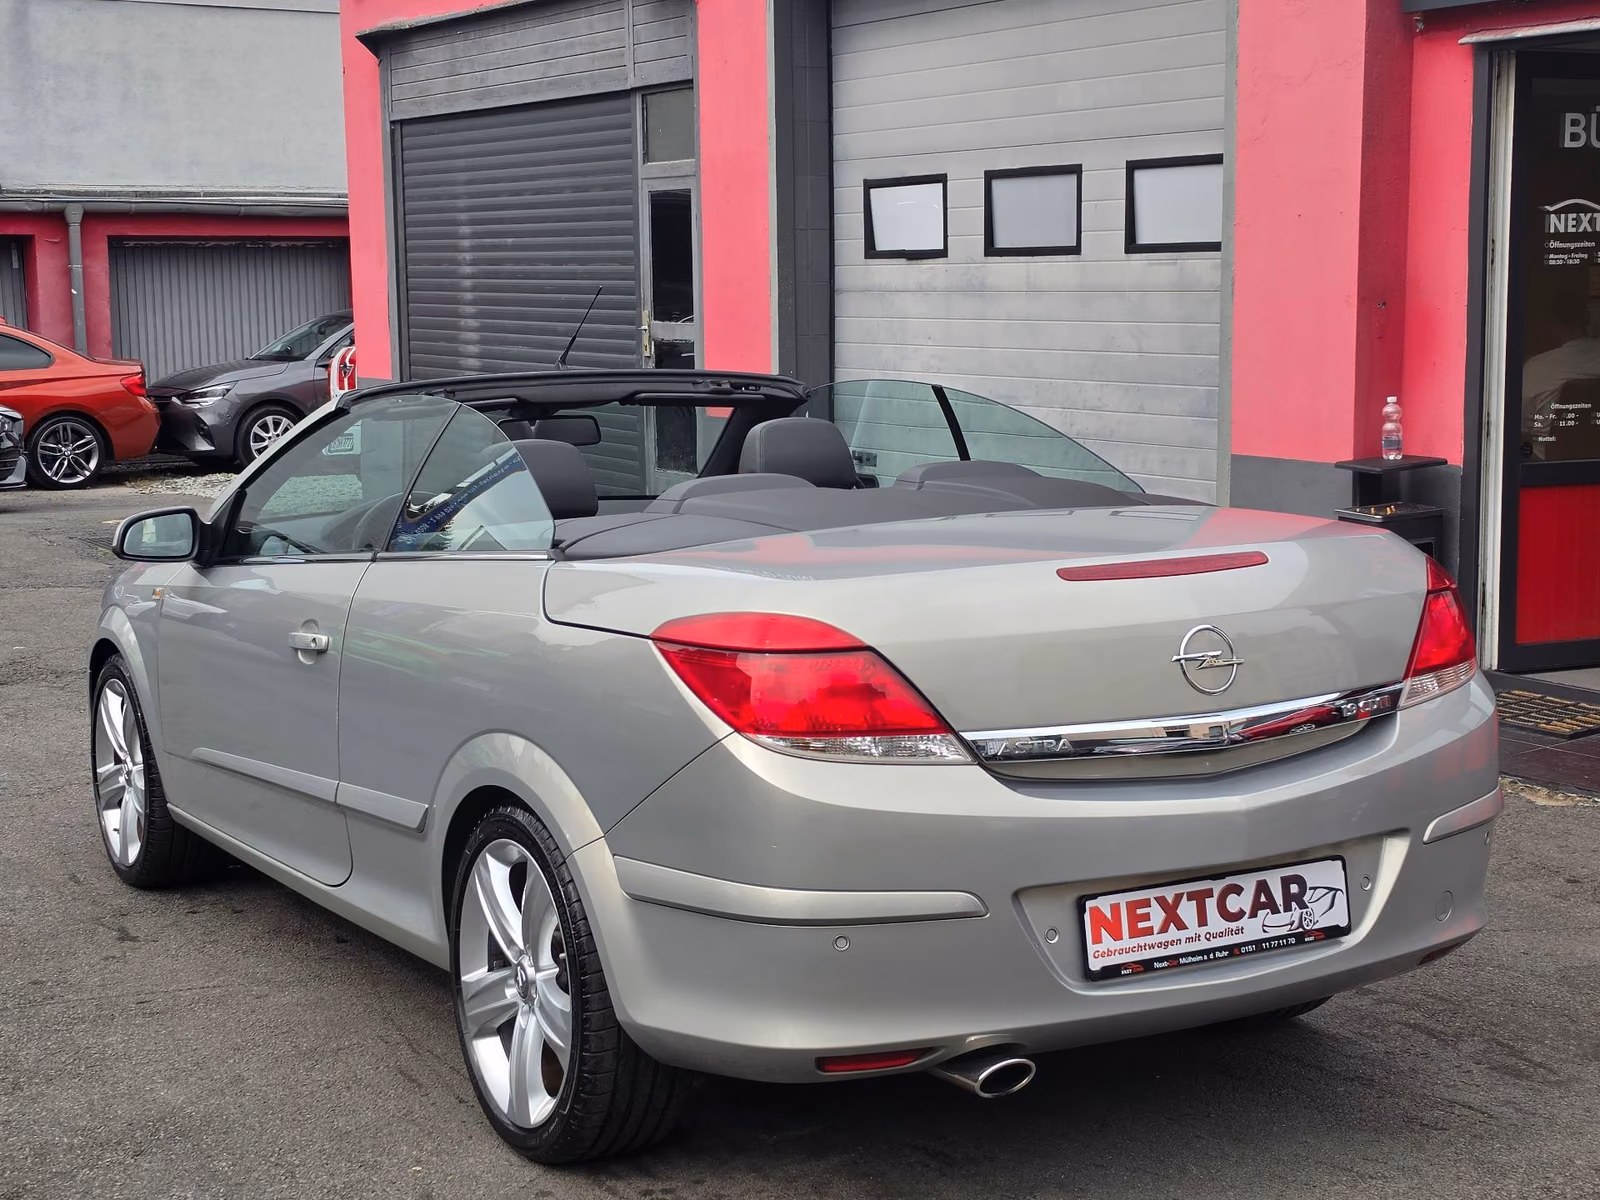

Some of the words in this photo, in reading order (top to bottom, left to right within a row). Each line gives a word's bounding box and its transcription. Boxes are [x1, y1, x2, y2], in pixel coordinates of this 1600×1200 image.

[1549, 240, 1596, 250] Öffnungszeiten
[1550, 402, 1592, 410] Öffnungszeiten
[997, 738, 1073, 756] ASTRA
[1088, 873, 1309, 945] NEXTCAR
[1092, 938, 1182, 960] Gebrauchtwagen
[1184, 931, 1201, 945] mit
[1204, 925, 1245, 942] Qualität
[1215, 950, 1230, 958] Ruhr
[1240, 944, 1256, 953] 0151
